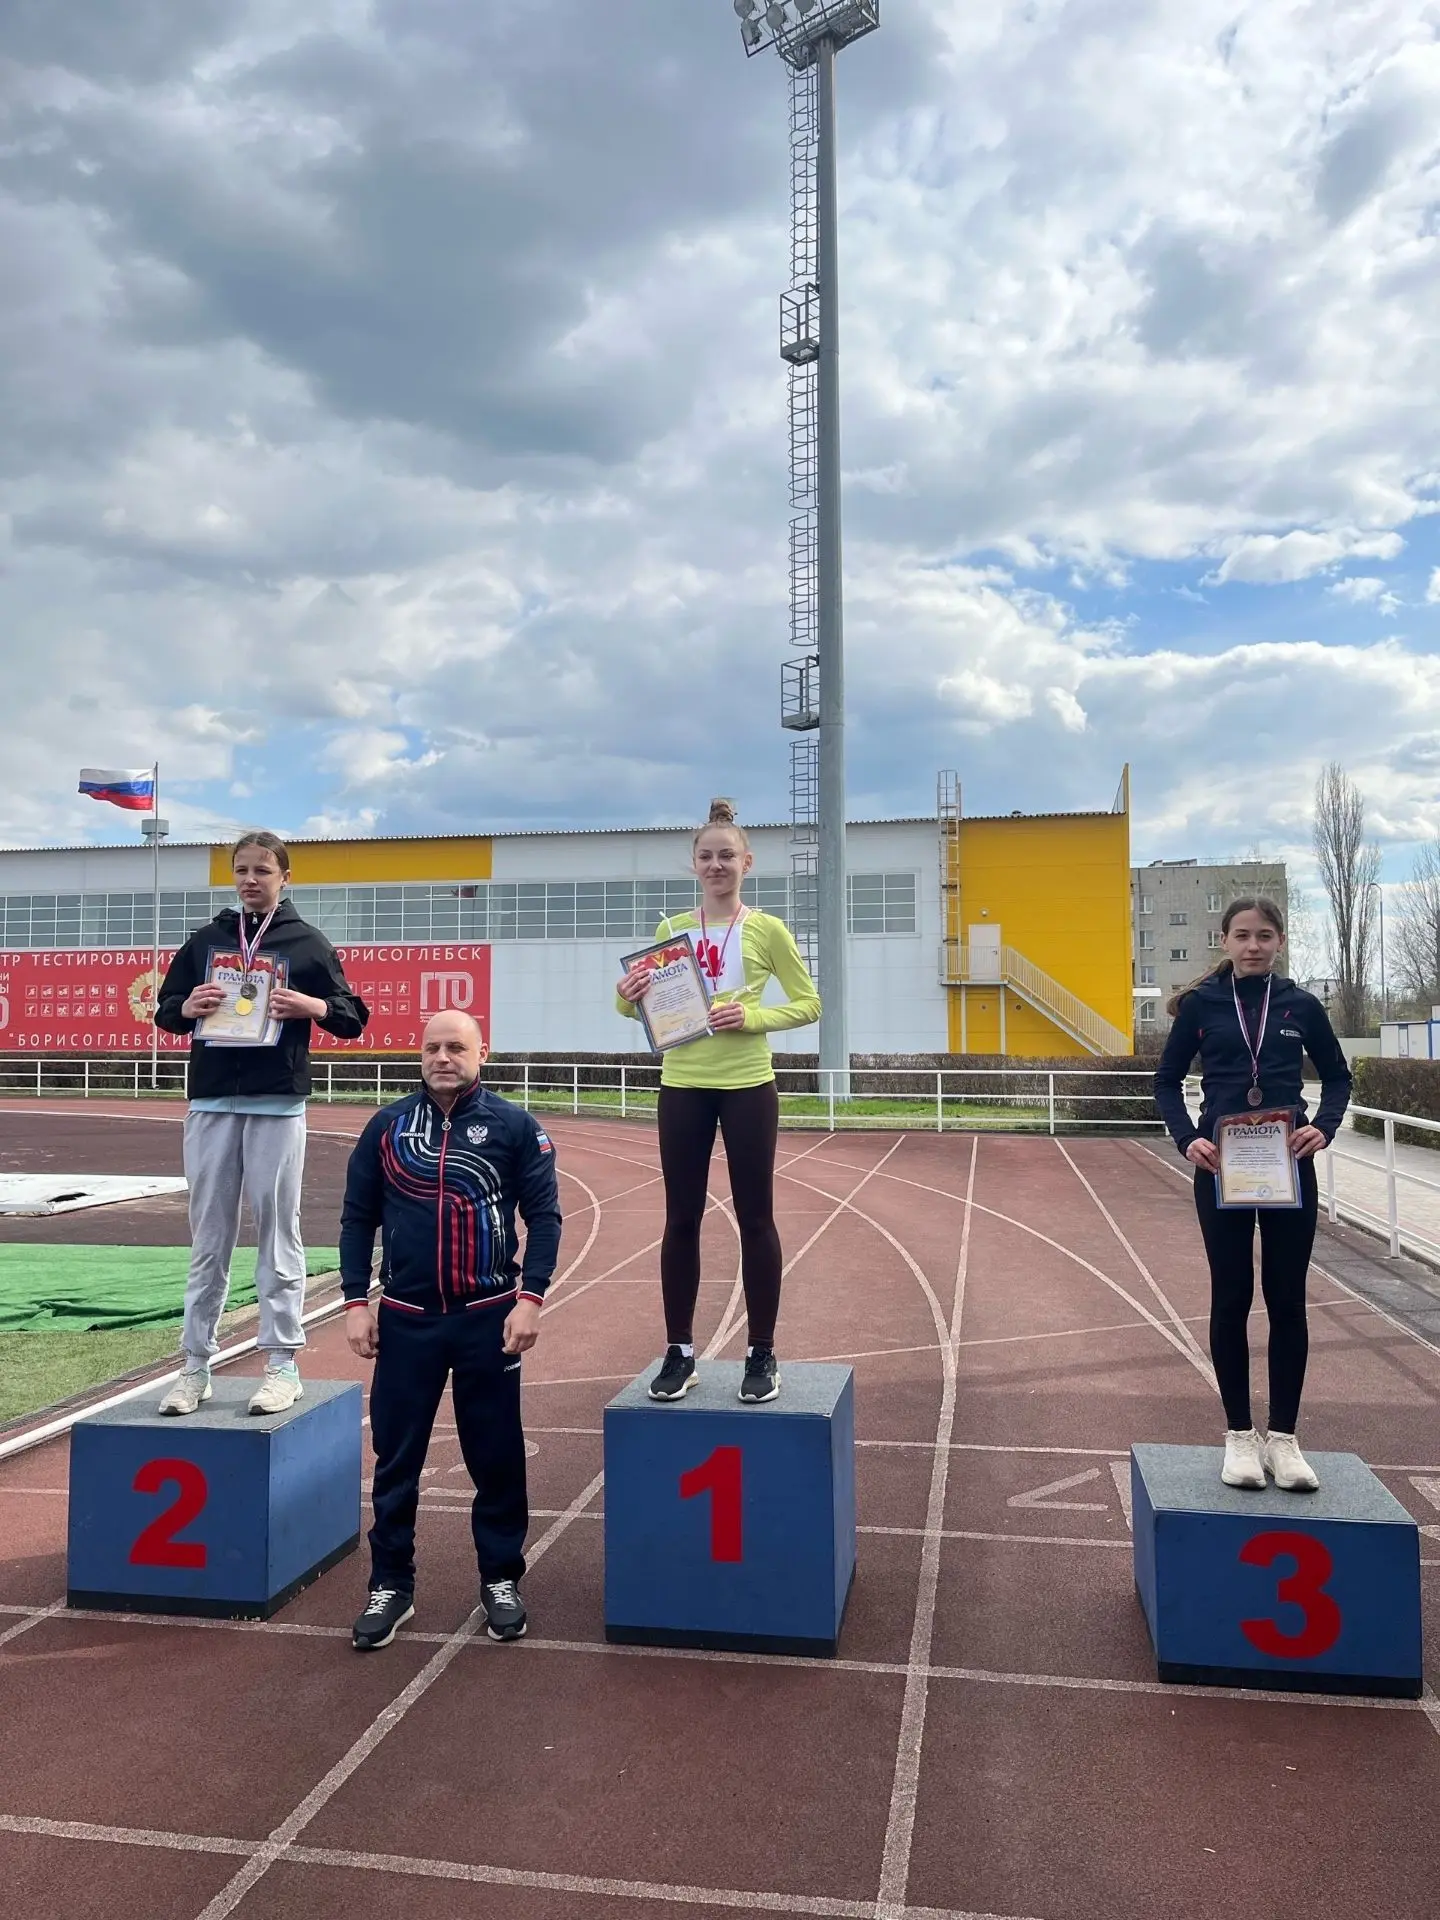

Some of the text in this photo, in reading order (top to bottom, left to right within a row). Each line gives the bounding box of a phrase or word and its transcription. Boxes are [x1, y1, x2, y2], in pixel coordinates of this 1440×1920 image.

[32, 951, 177, 967] ТЕСТИРОВАНИЯ
[336, 946, 481, 963] ОРИСОГЛЕБСК
[650, 962, 688, 981] АМОТА
[217, 971, 264, 984] ГРАМОТА
[420, 971, 474, 1010] ГТО
[1227, 1125, 1281, 1136] ГРАМОТА
[129, 1458, 208, 1568] 2
[679, 1446, 742, 1563] 1
[1238, 1530, 1342, 1658] 3
